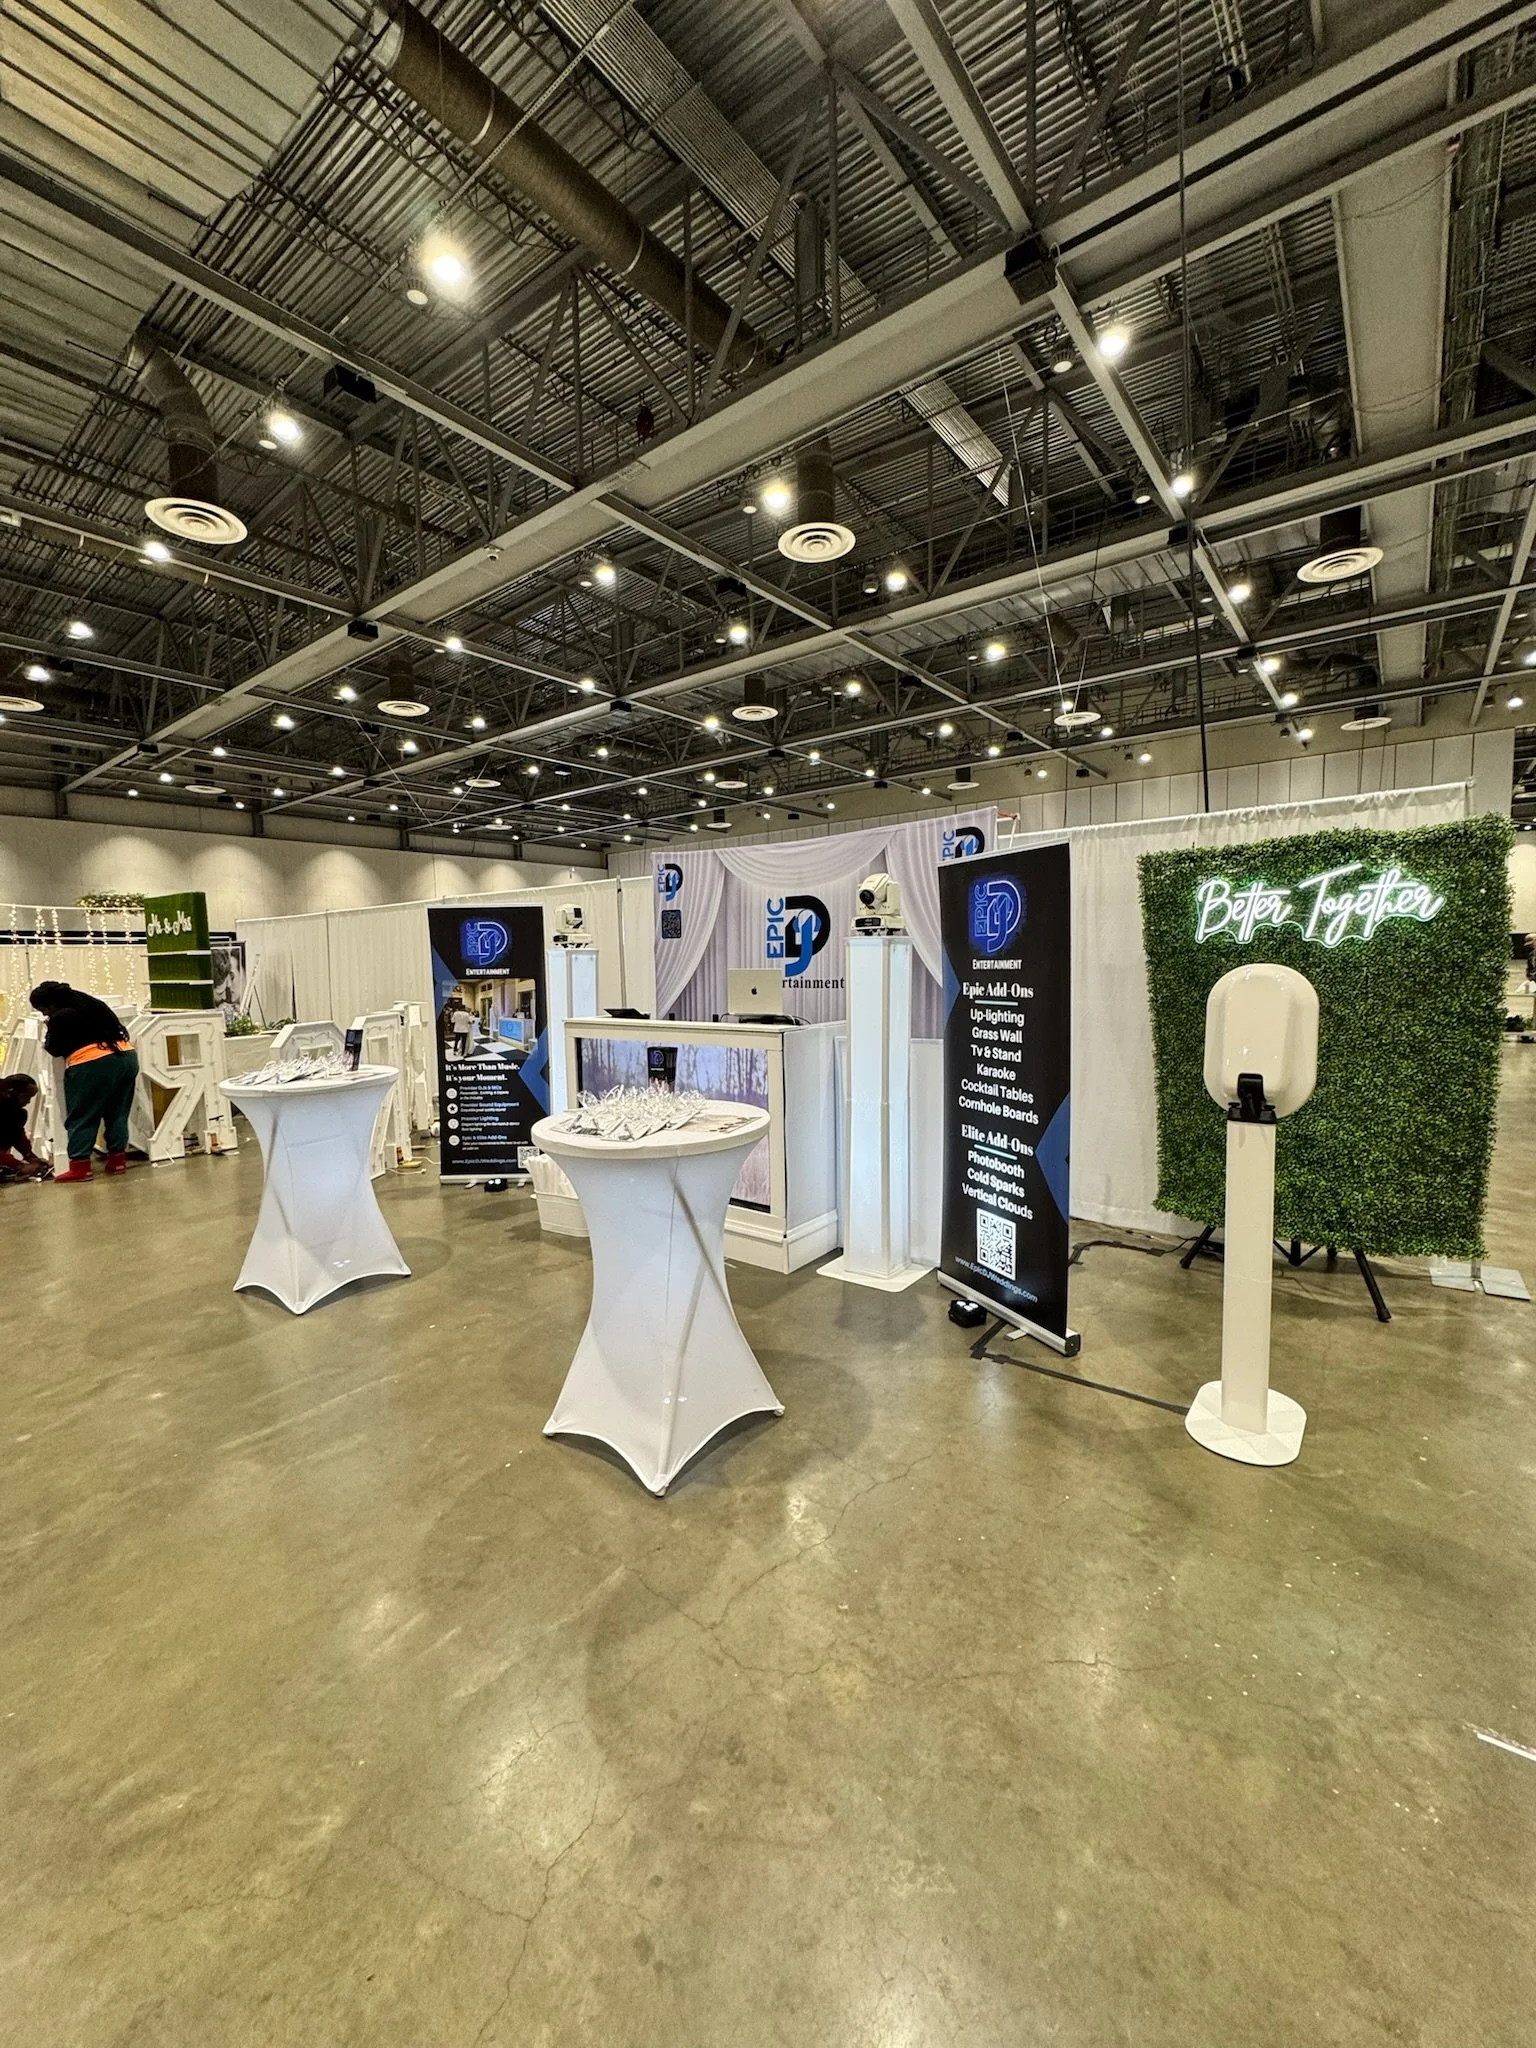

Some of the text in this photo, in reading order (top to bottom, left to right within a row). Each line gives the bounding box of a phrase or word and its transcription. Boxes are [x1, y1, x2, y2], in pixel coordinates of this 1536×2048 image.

[941, 829, 956, 861] PIC
[657, 863, 666, 894] EPIC
[974, 883, 988, 937] EPIC
[1198, 862, 1446, 946] Better Together
[465, 922, 480, 956] EPIC
[766, 896, 784, 959] EPIC
[782, 976, 845, 990] rtainment
[962, 981, 1034, 999] Epic Add-Ons
[970, 1008, 1025, 1027] Up-lighting
[971, 1026, 1023, 1044] Grass Wall
[458, 1063, 477, 1071] More
[477, 1062, 497, 1071] Than
[497, 1062, 520, 1071] Music.
[970, 1044, 1022, 1063] Tv & Stand
[458, 1075, 476, 1083] your
[476, 1073, 508, 1081] Moment.
[976, 1063, 1017, 1081] Karaoke
[960, 1078, 1034, 1104] Cocktail Tables
[958, 1095, 1039, 1125] Cornhole Boards
[961, 1123, 1034, 1157] Elite Add-Ons
[967, 1149, 1025, 1179] Photobooth
[967, 1167, 1025, 1198] Cold Sparks
[961, 1182, 1034, 1221] Vertical Clouds
[955, 1255, 1038, 1303] www.EpicDJWeddings.com
